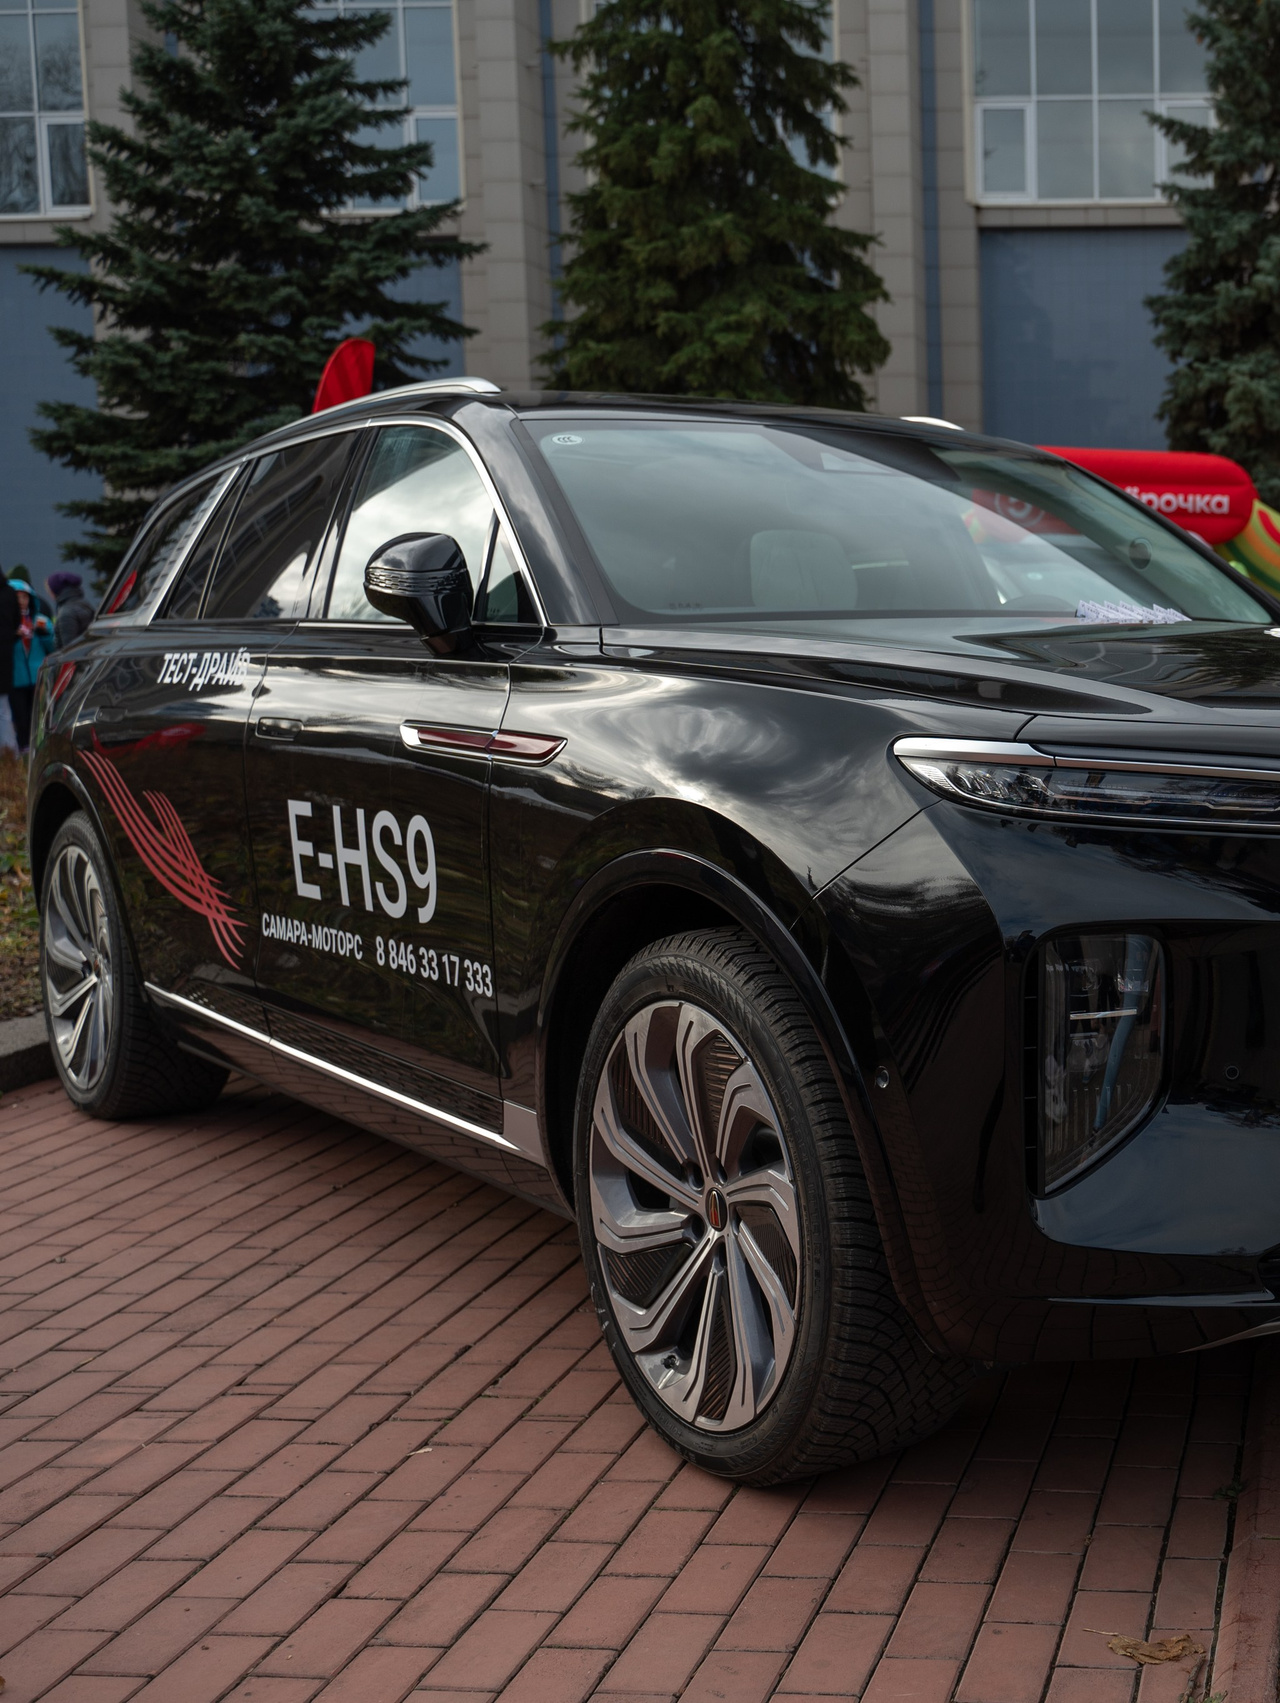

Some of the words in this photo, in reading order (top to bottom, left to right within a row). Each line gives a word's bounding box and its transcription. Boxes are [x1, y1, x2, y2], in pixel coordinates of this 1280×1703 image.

[157, 647, 251, 691] ТЕСТ-ДРАЙВ
[287, 799, 438, 924] E-HS9
[262, 912, 363, 960] САМАРА-МОТОРС
[376, 940, 386, 966] 8
[388, 943, 416, 973] 846
[418, 950, 440, 981] 33
[441, 955, 460, 986] 17
[465, 961, 493, 997] 333
